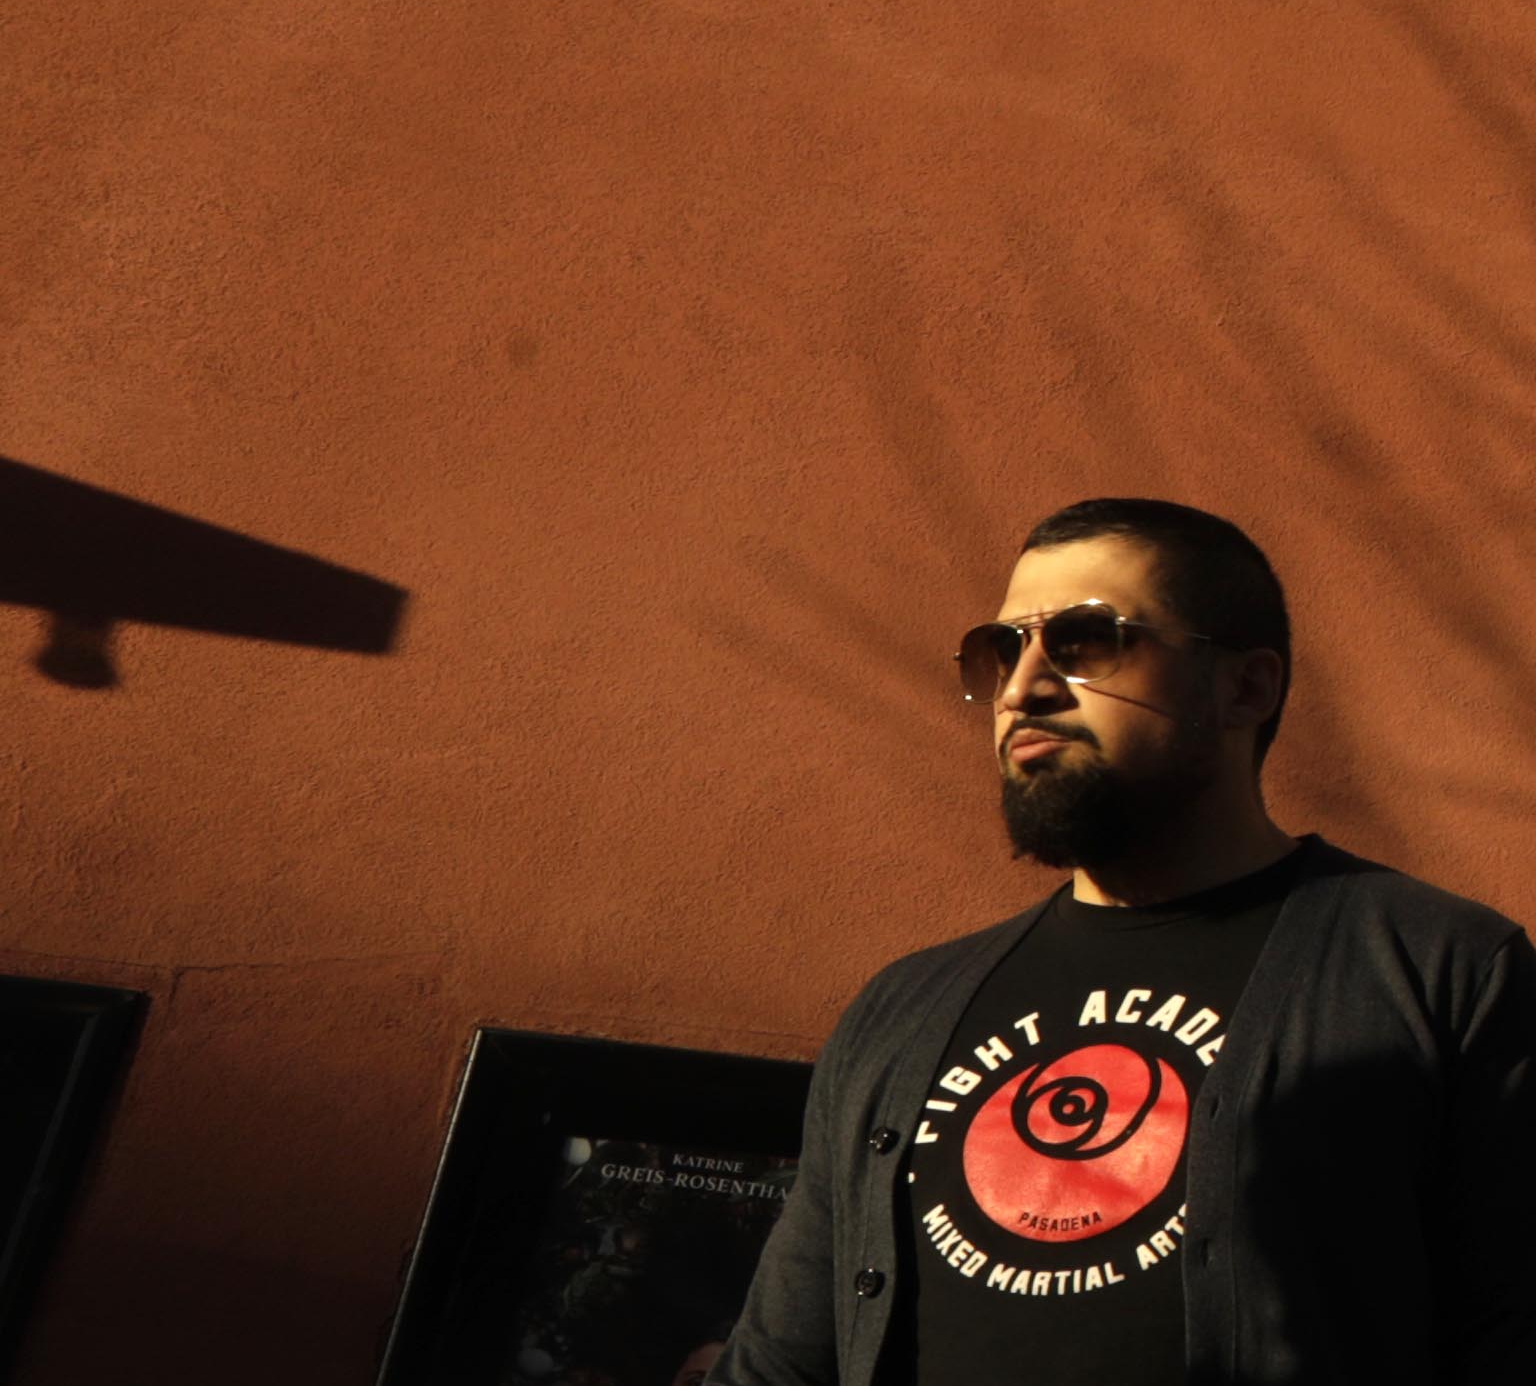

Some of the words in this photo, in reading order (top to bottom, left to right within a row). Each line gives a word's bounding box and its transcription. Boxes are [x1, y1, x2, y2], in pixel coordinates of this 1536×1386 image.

[914, 1012, 1041, 1145] FIGHT
[672, 1153, 744, 1175] KATRINE
[923, 1204, 989, 1278] MIXED
[986, 1262, 1125, 1296] MARTIAL
[1019, 1211, 1102, 1232] PASADENA
